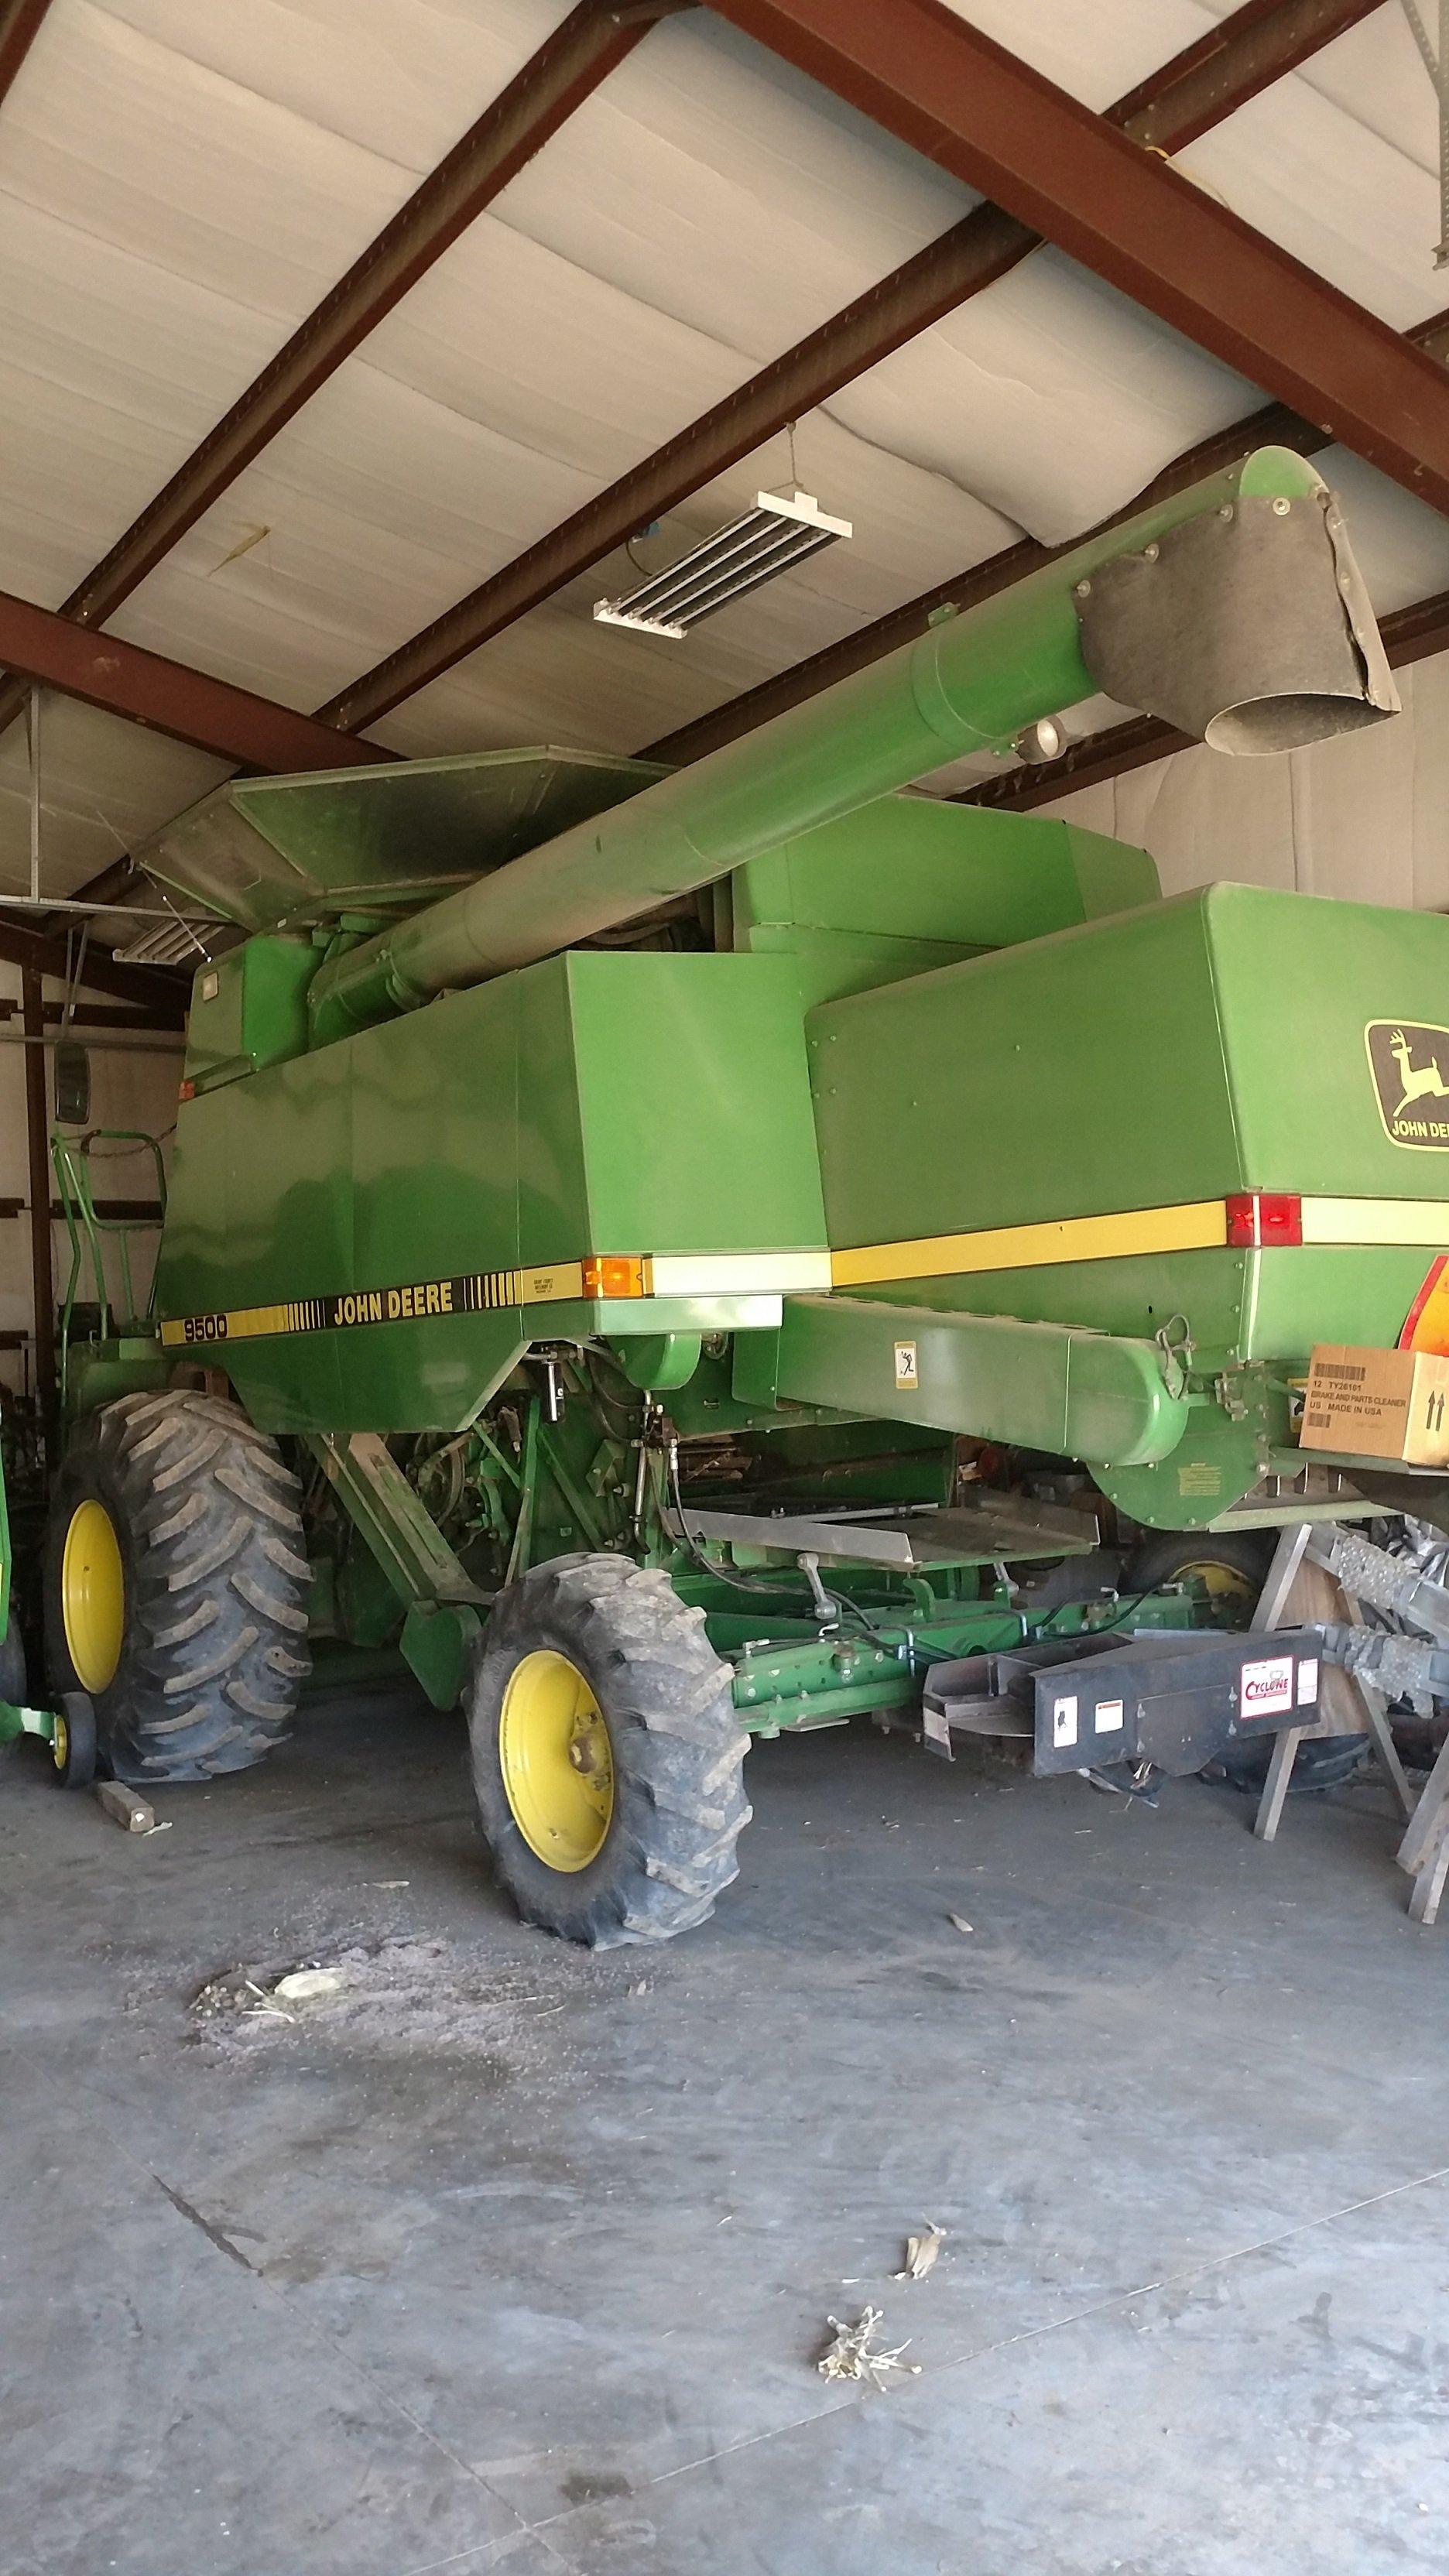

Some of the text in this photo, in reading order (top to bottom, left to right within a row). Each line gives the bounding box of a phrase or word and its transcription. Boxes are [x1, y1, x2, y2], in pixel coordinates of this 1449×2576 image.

[1392, 1120, 1428, 1137] JOHN
[334, 1281, 453, 1325] JOHN DEERE
[183, 1314, 228, 1342] 9500
[1310, 1390, 1406, 1407] BRAKE AND PARTS CLEANER
[1309, 1401, 1382, 1416] US MADE IN USA
